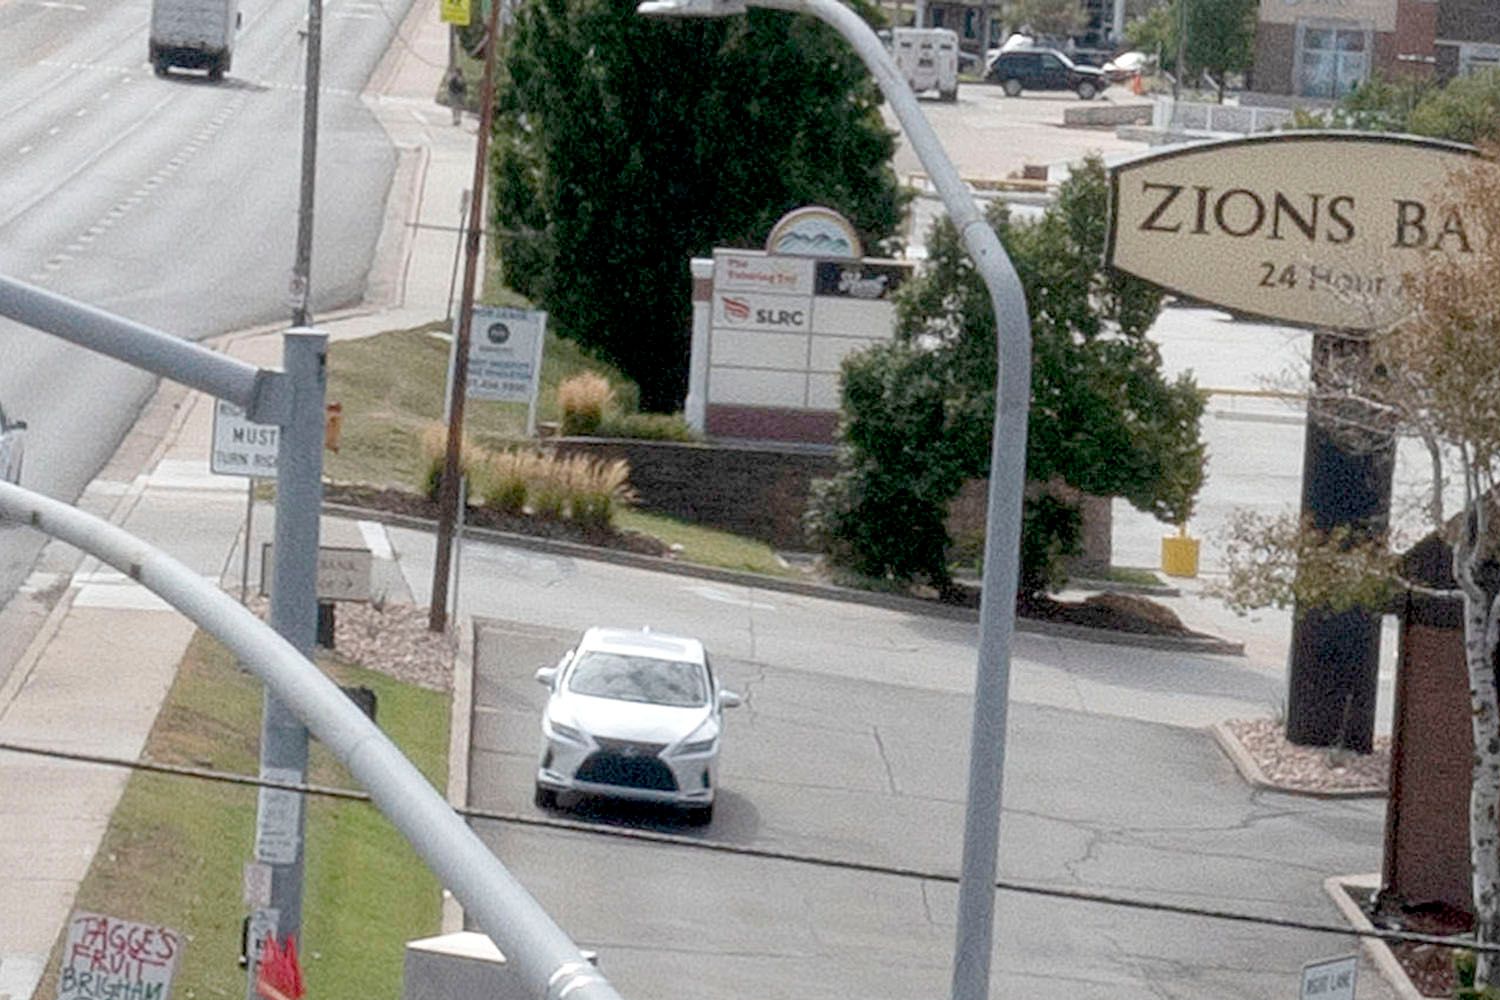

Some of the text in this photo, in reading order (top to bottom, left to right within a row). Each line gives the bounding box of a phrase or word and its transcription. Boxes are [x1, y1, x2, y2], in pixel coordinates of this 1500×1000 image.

[1139, 181, 1475, 253] ZIONS BA
[1258, 262, 1297, 290] 24
[755, 308, 805, 326] SLRC
[232, 427, 277, 446] MUST
[75, 917, 178, 960] TAGGE'S
[71, 943, 166, 981] FRUIT
